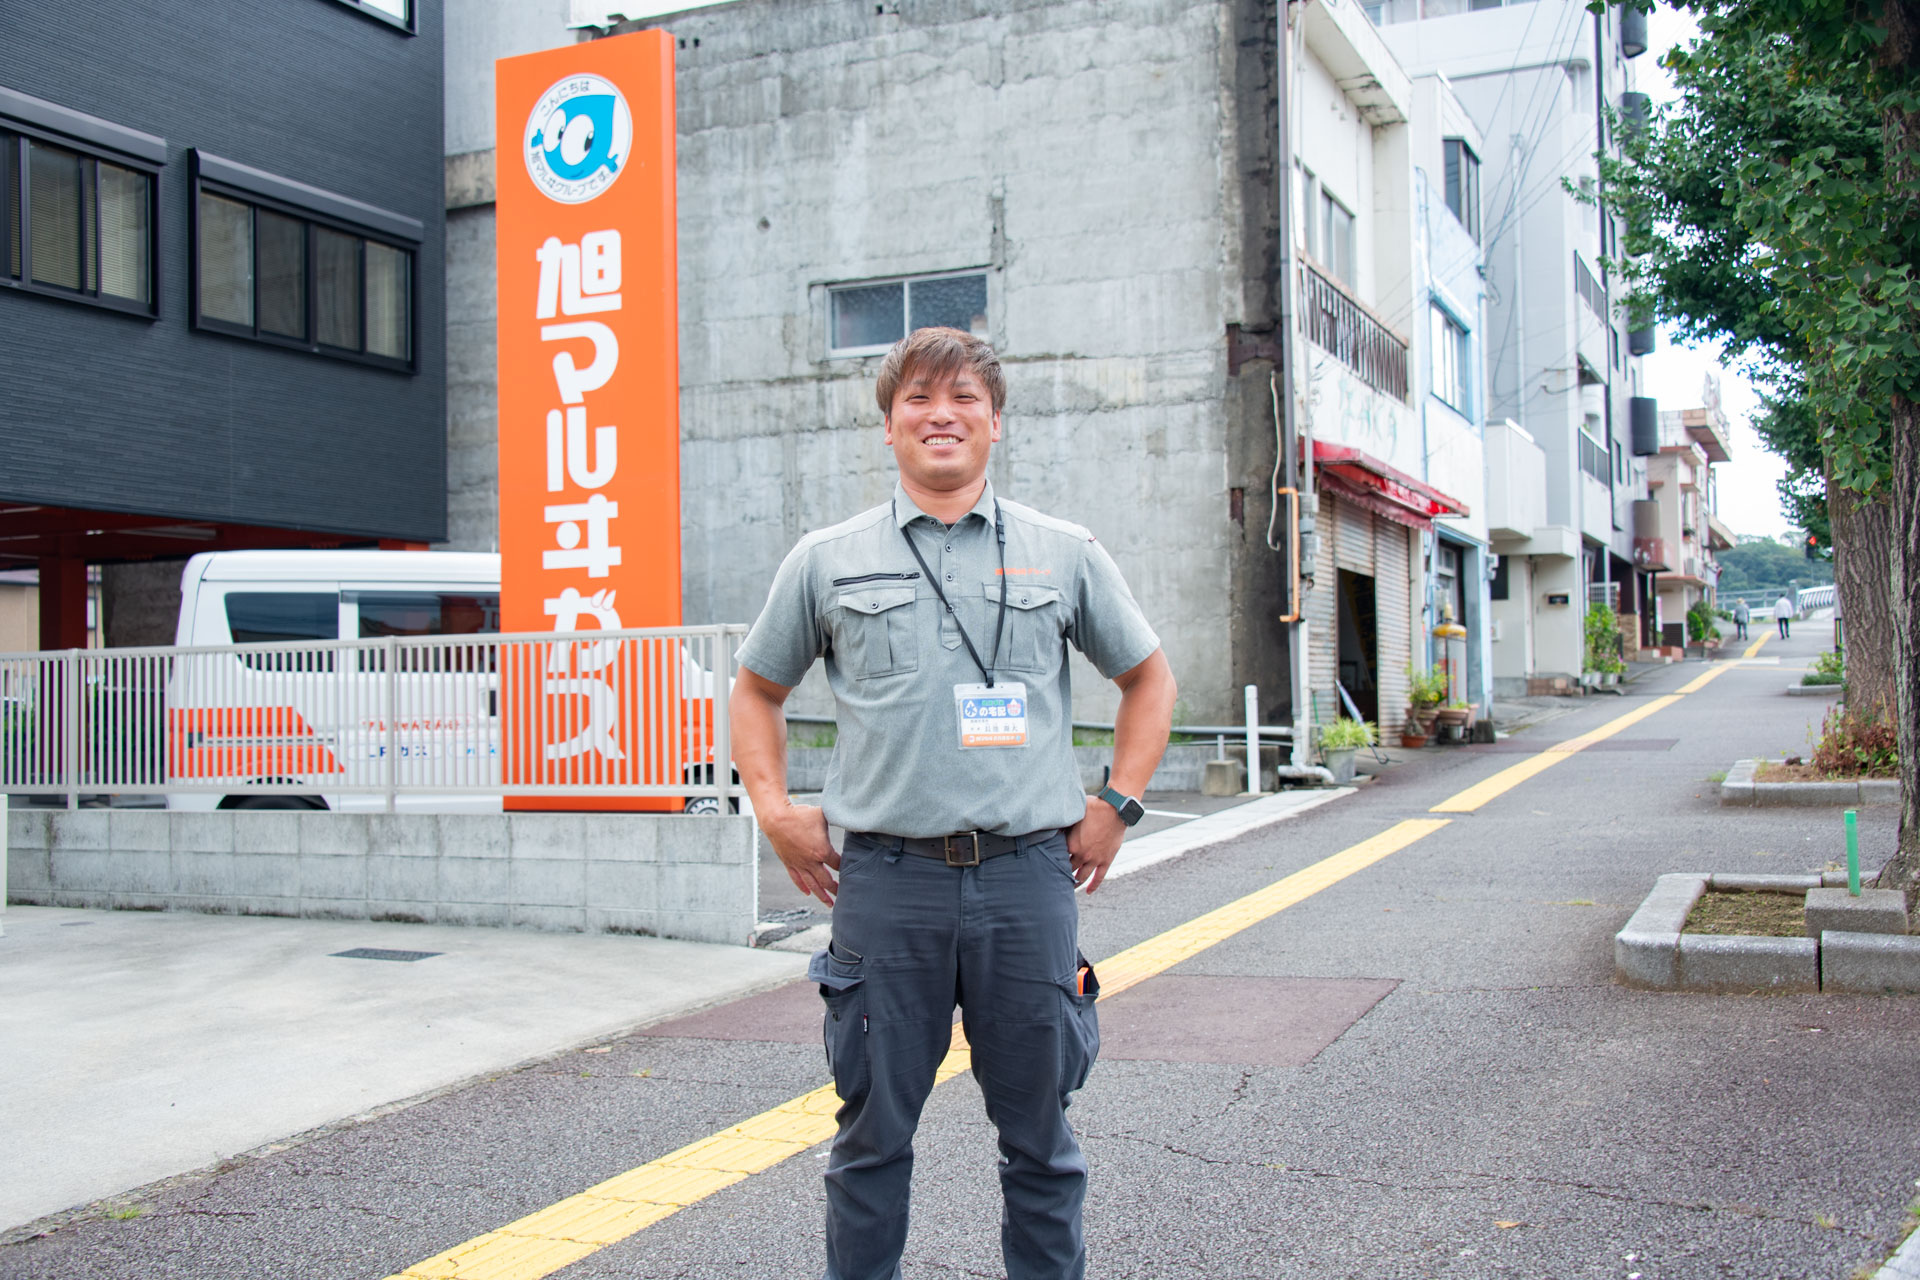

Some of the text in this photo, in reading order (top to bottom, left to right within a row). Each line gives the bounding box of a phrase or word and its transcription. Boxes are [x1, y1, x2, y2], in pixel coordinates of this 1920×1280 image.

[540, 80, 590, 118] こんにちは
